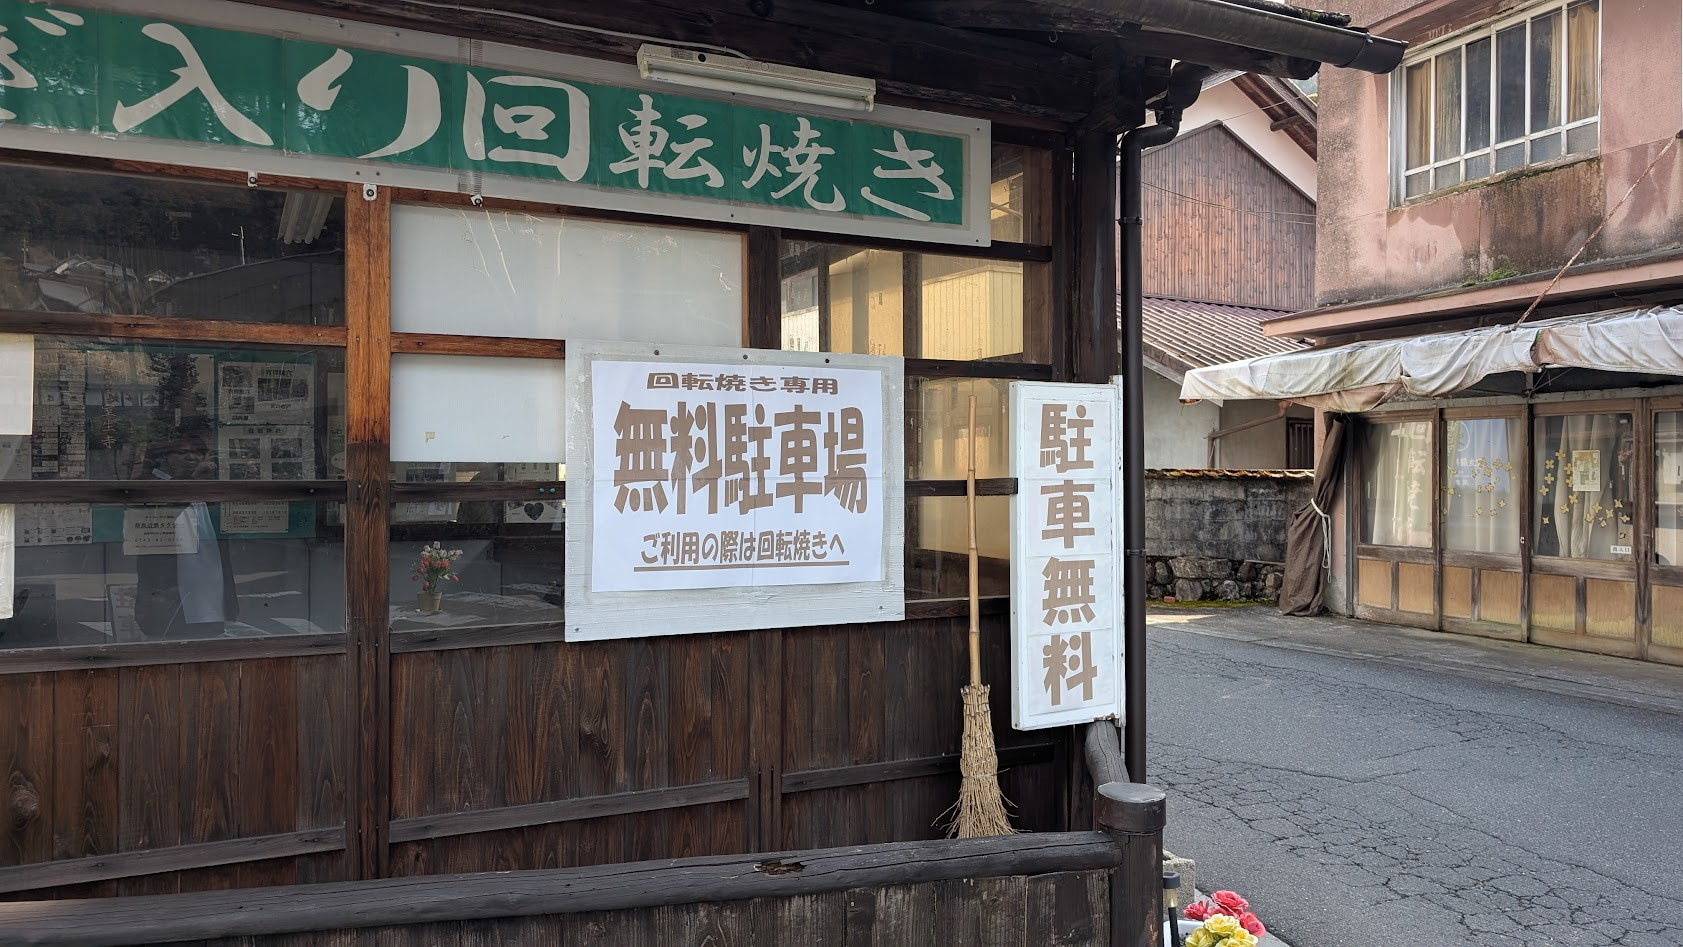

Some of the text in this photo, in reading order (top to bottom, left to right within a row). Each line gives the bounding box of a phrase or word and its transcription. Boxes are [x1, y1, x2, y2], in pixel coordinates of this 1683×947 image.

[646, 372, 839, 396] 回転焼き専用
[613, 400, 867, 516] 無料駐車場
[640, 529, 846, 565] ご利用の際は回転焼きへ
[1039, 403, 1098, 706] 駐車無料
